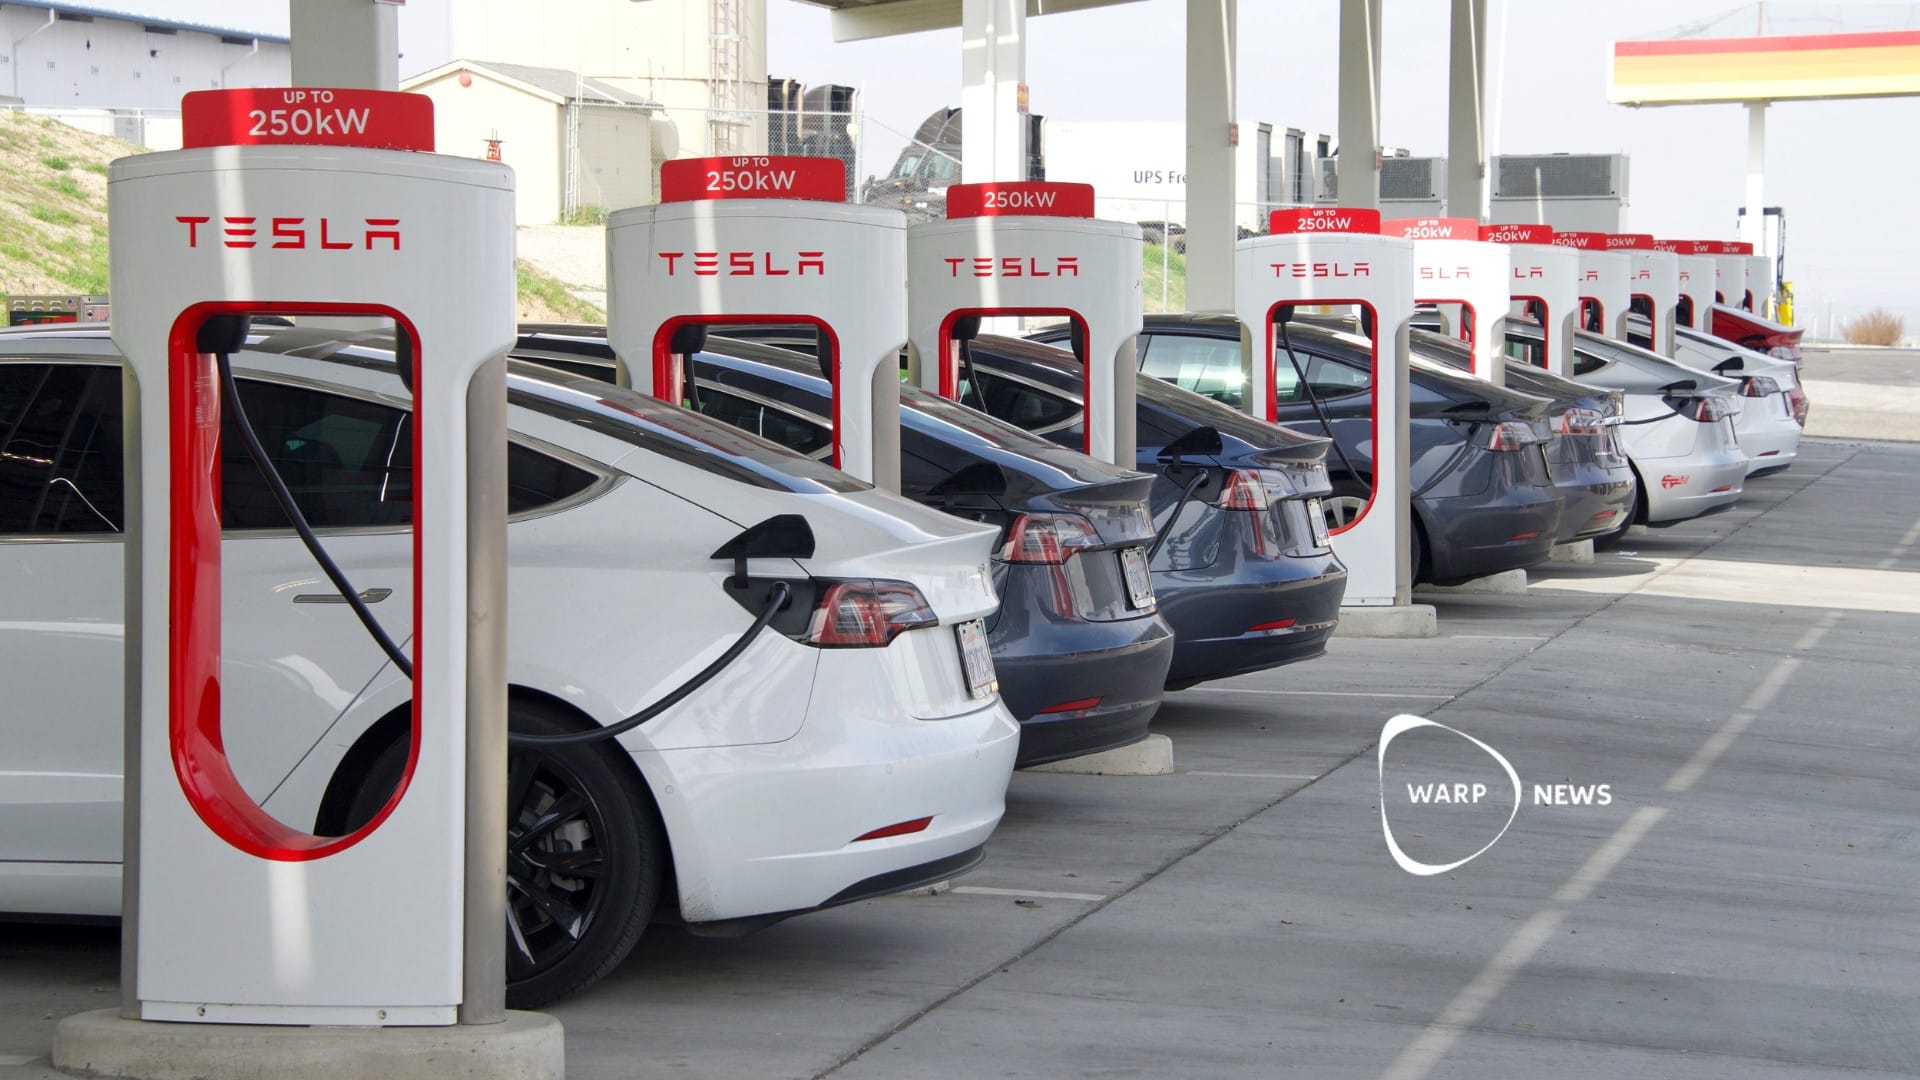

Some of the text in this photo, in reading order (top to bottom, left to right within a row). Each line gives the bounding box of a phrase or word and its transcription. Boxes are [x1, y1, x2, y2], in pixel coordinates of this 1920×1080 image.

[283, 90, 334, 104] UP TO
[249, 108, 370, 136] 250kW
[733, 157, 769, 167] UP TO
[706, 170, 796, 191] 250kW
[1134, 170, 1162, 184] UPS
[984, 191, 1056, 208] 250kW
[1297, 217, 1351, 230] 250kW
[175, 216, 400, 250] TESLA
[1404, 226, 1452, 239] 250kW
[1488, 230, 1531, 242] 250kW
[1606, 238, 1636, 247] 50kW
[658, 251, 824, 276] TESLA
[944, 257, 1078, 277] TESLA
[1270, 262, 1370, 278] TESLA
[1420, 267, 1470, 279] SLA
